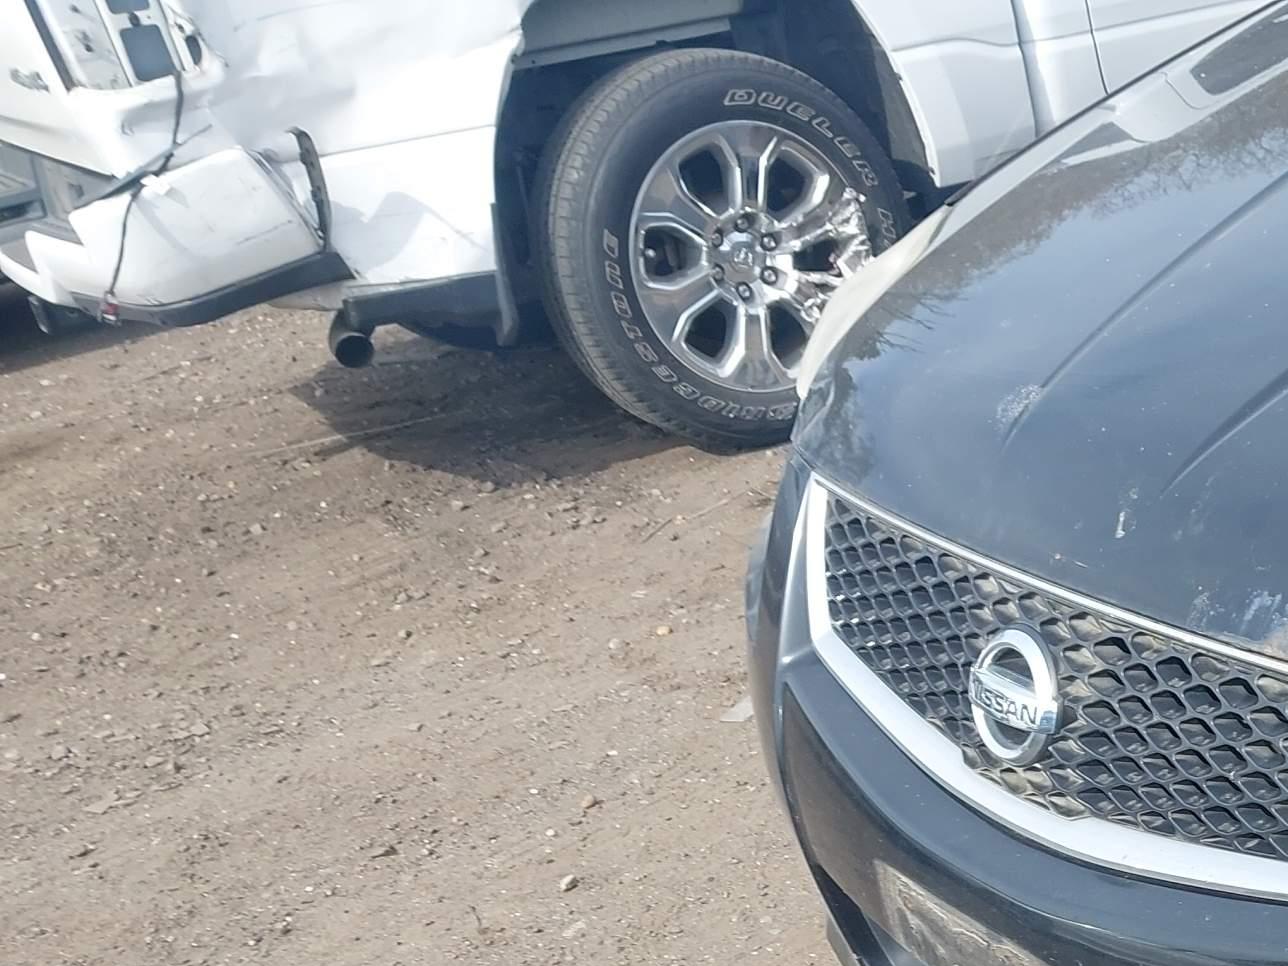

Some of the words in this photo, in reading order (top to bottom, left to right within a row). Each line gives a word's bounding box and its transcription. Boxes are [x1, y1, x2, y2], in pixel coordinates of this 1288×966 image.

[723, 88, 879, 187] DUELER
[603, 228, 798, 420] BRIDGESTONE
[972, 679, 1038, 725] NISSAN
